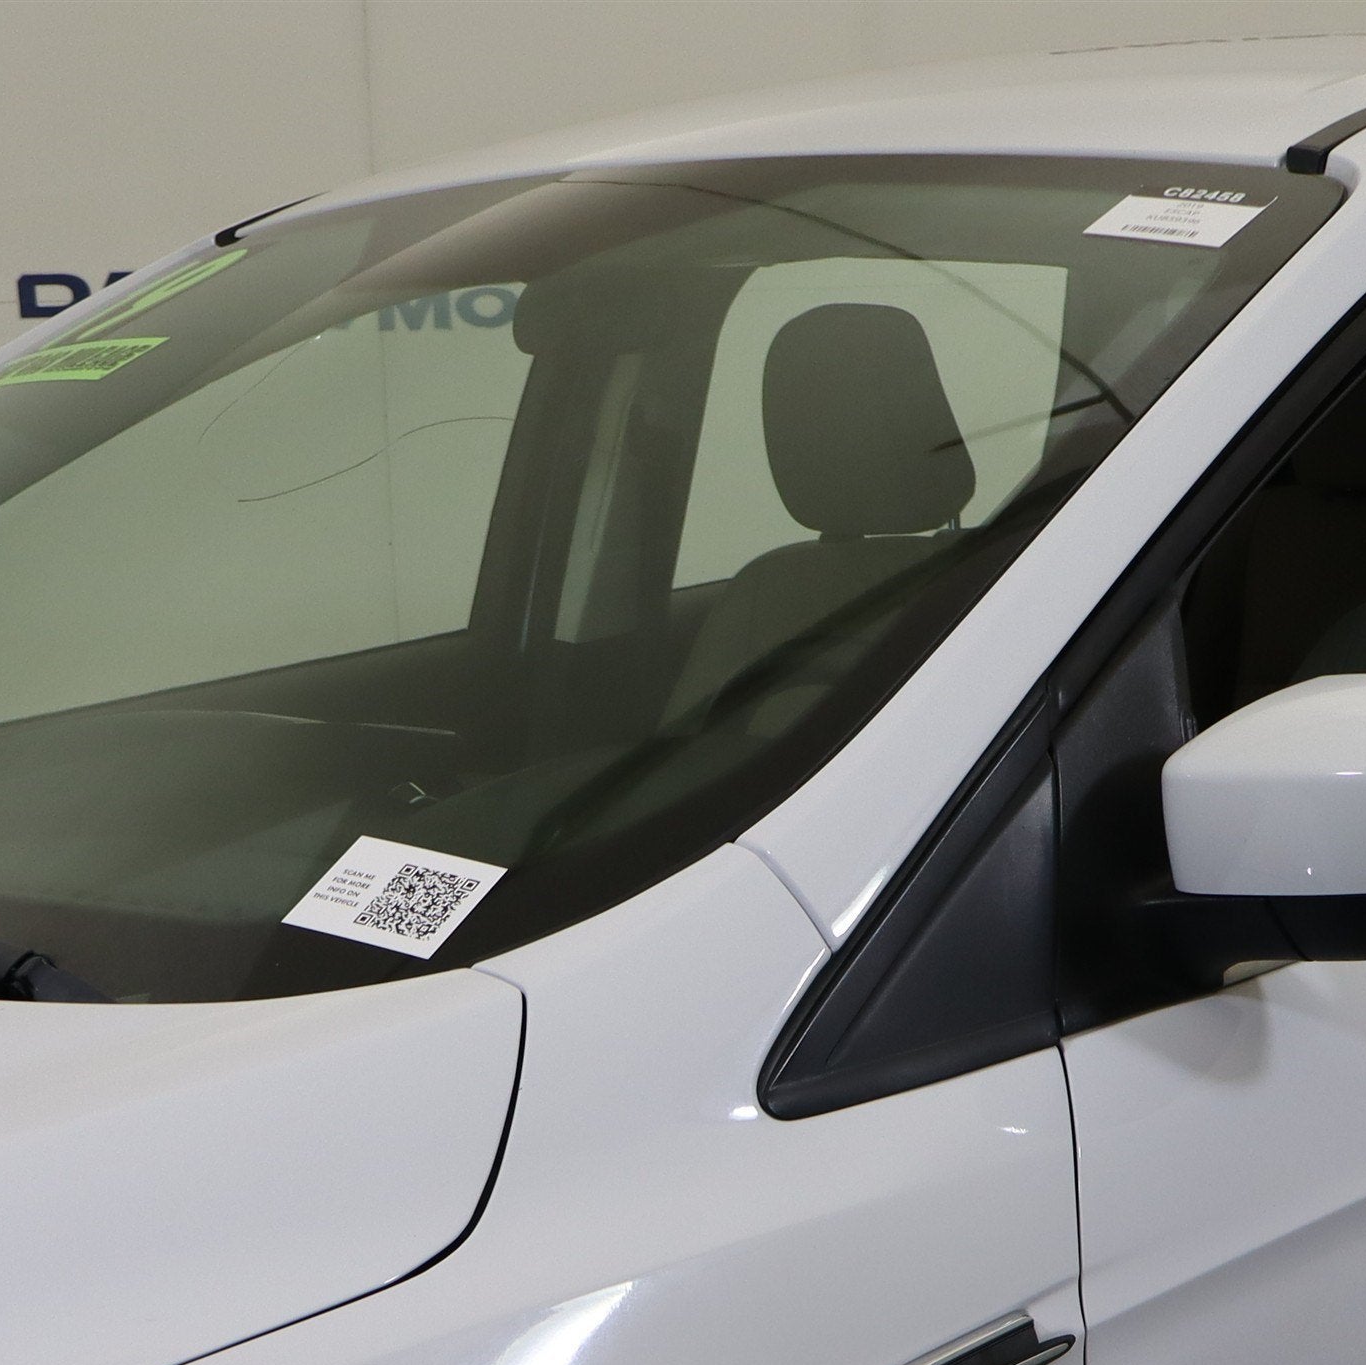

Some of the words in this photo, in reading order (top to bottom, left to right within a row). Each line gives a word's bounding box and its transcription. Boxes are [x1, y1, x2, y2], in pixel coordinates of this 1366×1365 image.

[343, 868, 364, 878] SCAN
[363, 873, 376, 881] ME
[332, 876, 348, 884] FOR
[348, 880, 372, 889] MORE
[326, 885, 346, 894] INFO
[347, 890, 361, 898] ON
[313, 892, 330, 900] THIS
[330, 896, 360, 907] VEHICLE
